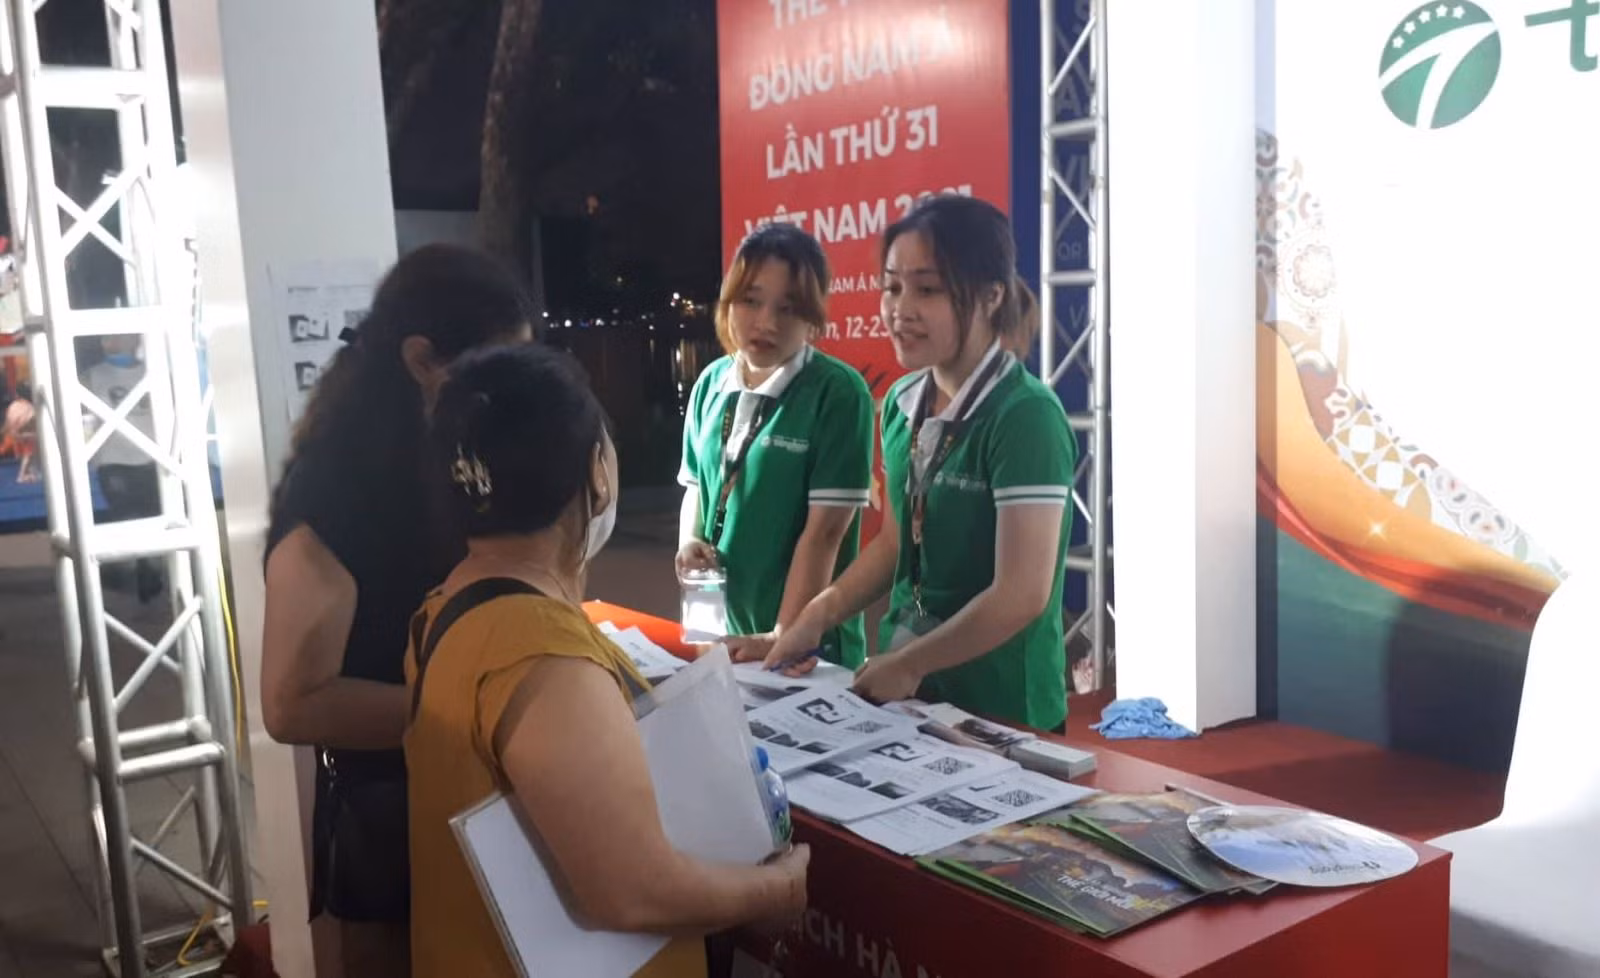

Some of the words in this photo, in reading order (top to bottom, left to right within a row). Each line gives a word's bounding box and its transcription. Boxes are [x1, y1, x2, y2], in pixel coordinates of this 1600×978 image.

[767, 122, 824, 179] LẦN
[829, 105, 899, 165] THỨ
[905, 105, 938, 151] 31
[814, 198, 887, 243] NAM
